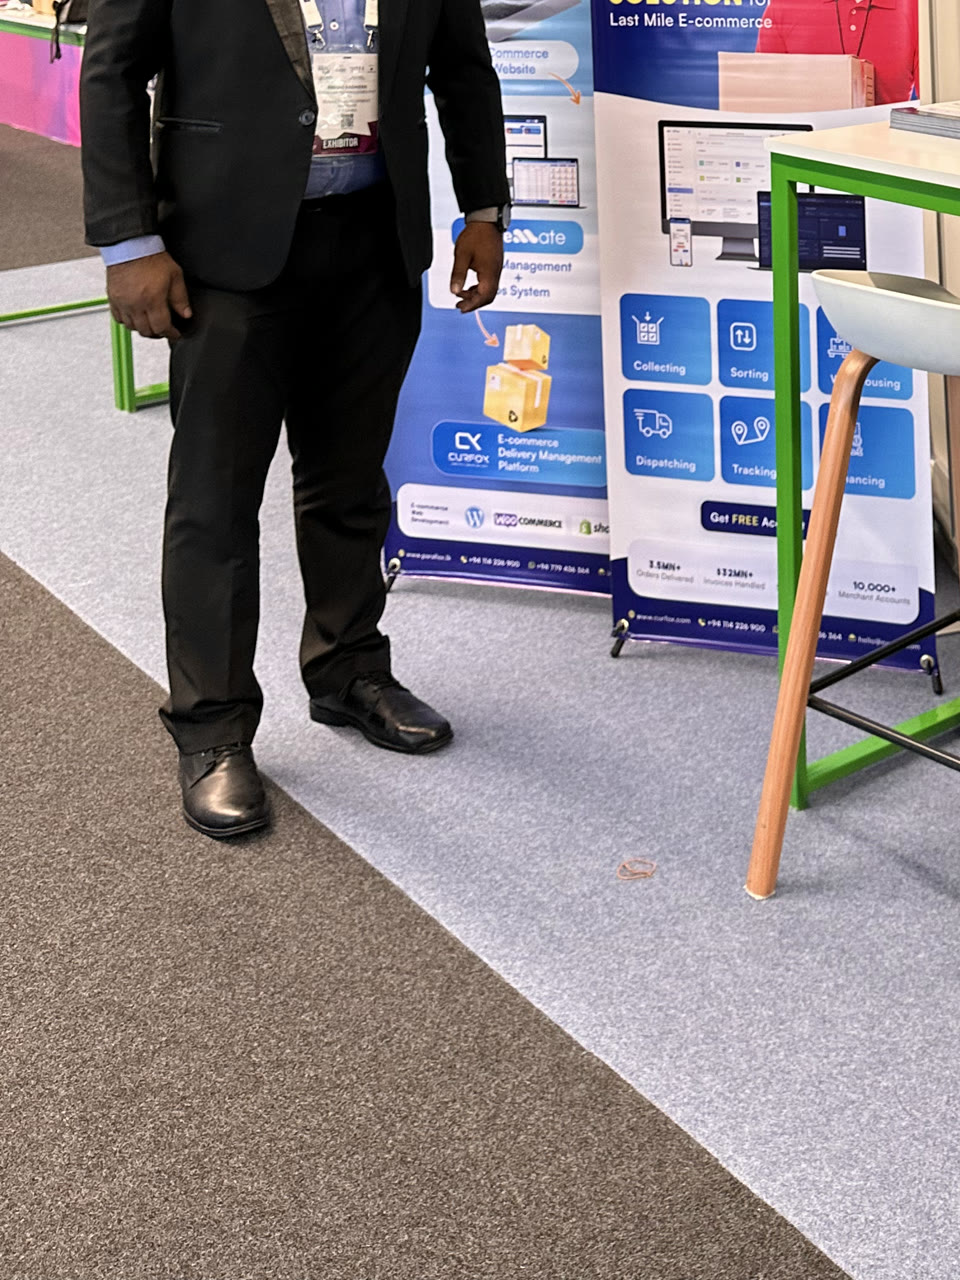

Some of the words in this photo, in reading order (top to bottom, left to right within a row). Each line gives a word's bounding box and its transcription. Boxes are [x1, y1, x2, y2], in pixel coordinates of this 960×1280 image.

[609, 12, 639, 27] Last
[643, 12, 674, 27] Mile
[678, 13, 773, 29] E-commerce
[321, 136, 360, 150] EXHIBITOR
[510, 285, 551, 299] System
[633, 360, 686, 376] Collecting
[730, 367, 769, 382] Sorting
[497, 433, 559, 448] E-commerce
[448, 451, 490, 464] CURFOX
[498, 448, 537, 462] Delivery
[539, 450, 602, 466] Management
[636, 455, 697, 473] Dispatching
[498, 461, 540, 474] Platform
[731, 464, 777, 480] Tracking
[709, 511, 730, 524] Get
[731, 513, 760, 527] FREE
[636, 568, 660, 580] Orders
[661, 571, 695, 584] Delivered
[853, 580, 897, 593] 10,000+
[837, 591, 874, 602] Merchant
[875, 594, 912, 606] Accounts
